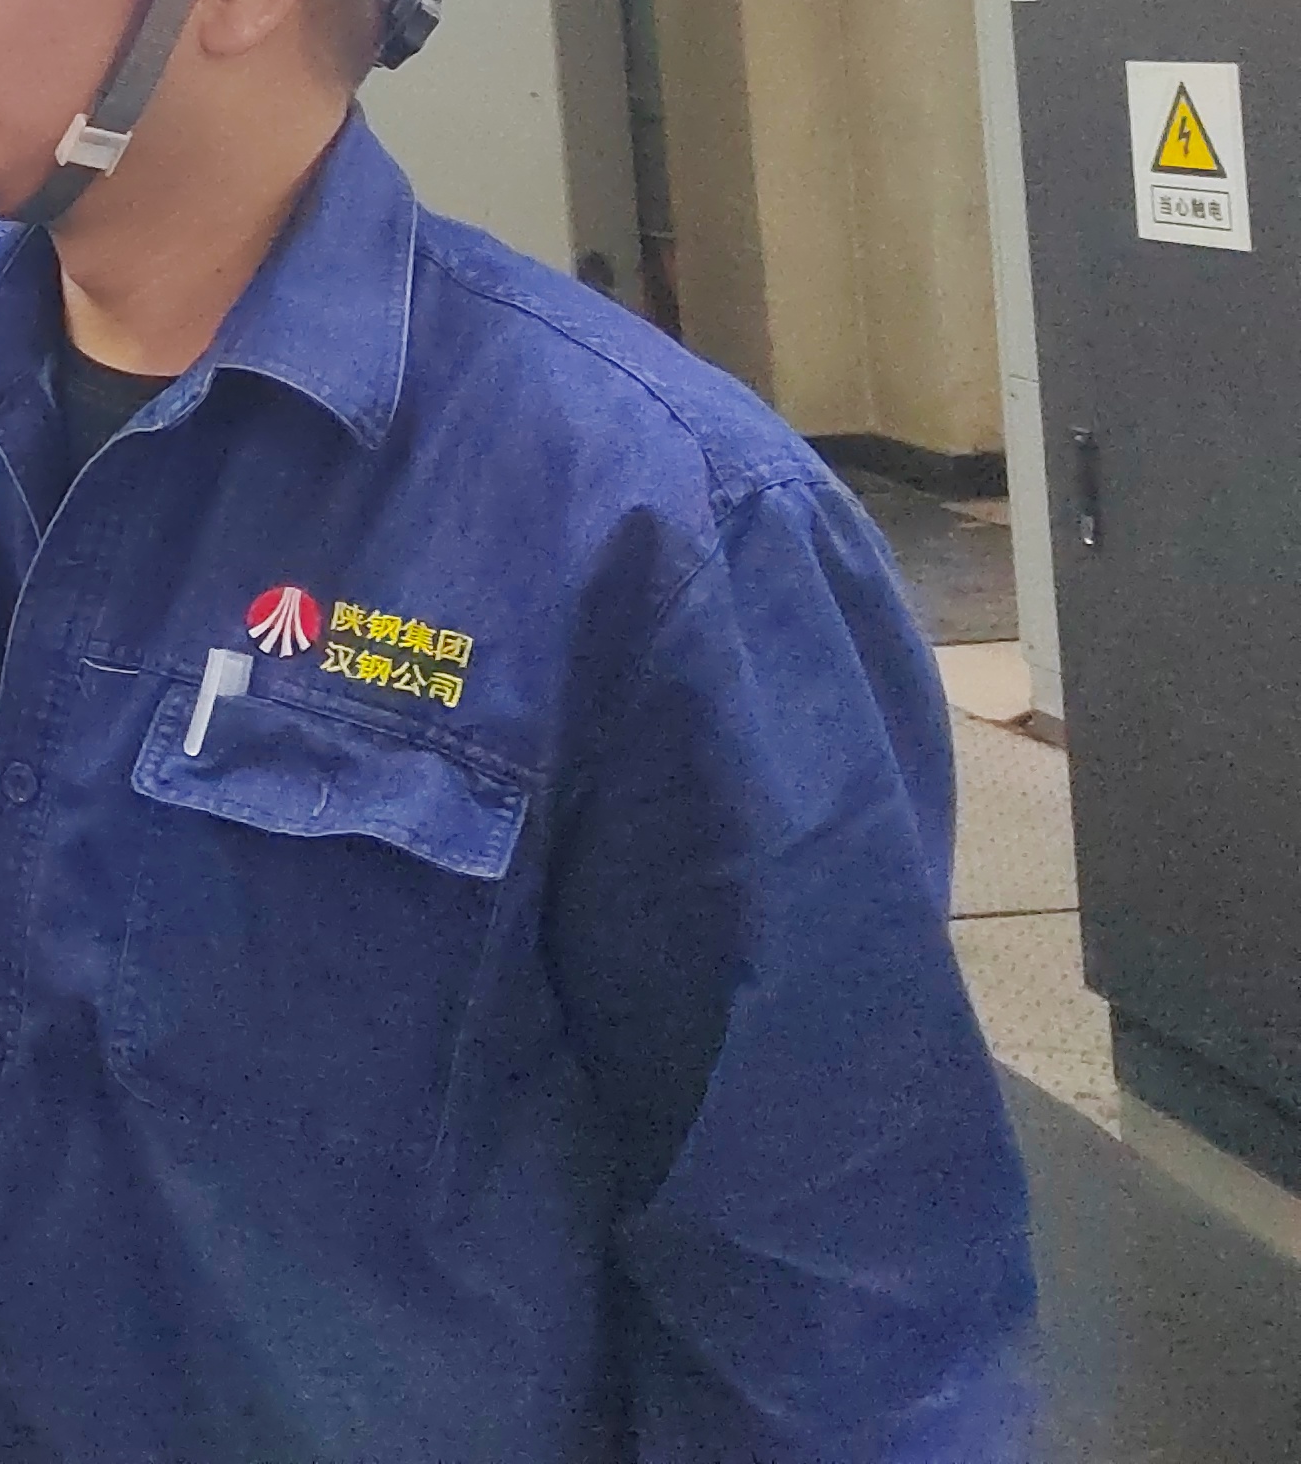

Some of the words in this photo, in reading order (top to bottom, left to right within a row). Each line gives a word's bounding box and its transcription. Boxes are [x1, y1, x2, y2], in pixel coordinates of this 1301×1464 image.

[1159, 195, 1223, 221] 当心触电
[330, 601, 474, 668] 陕钢集团
[320, 641, 464, 708] 汉钢公司
